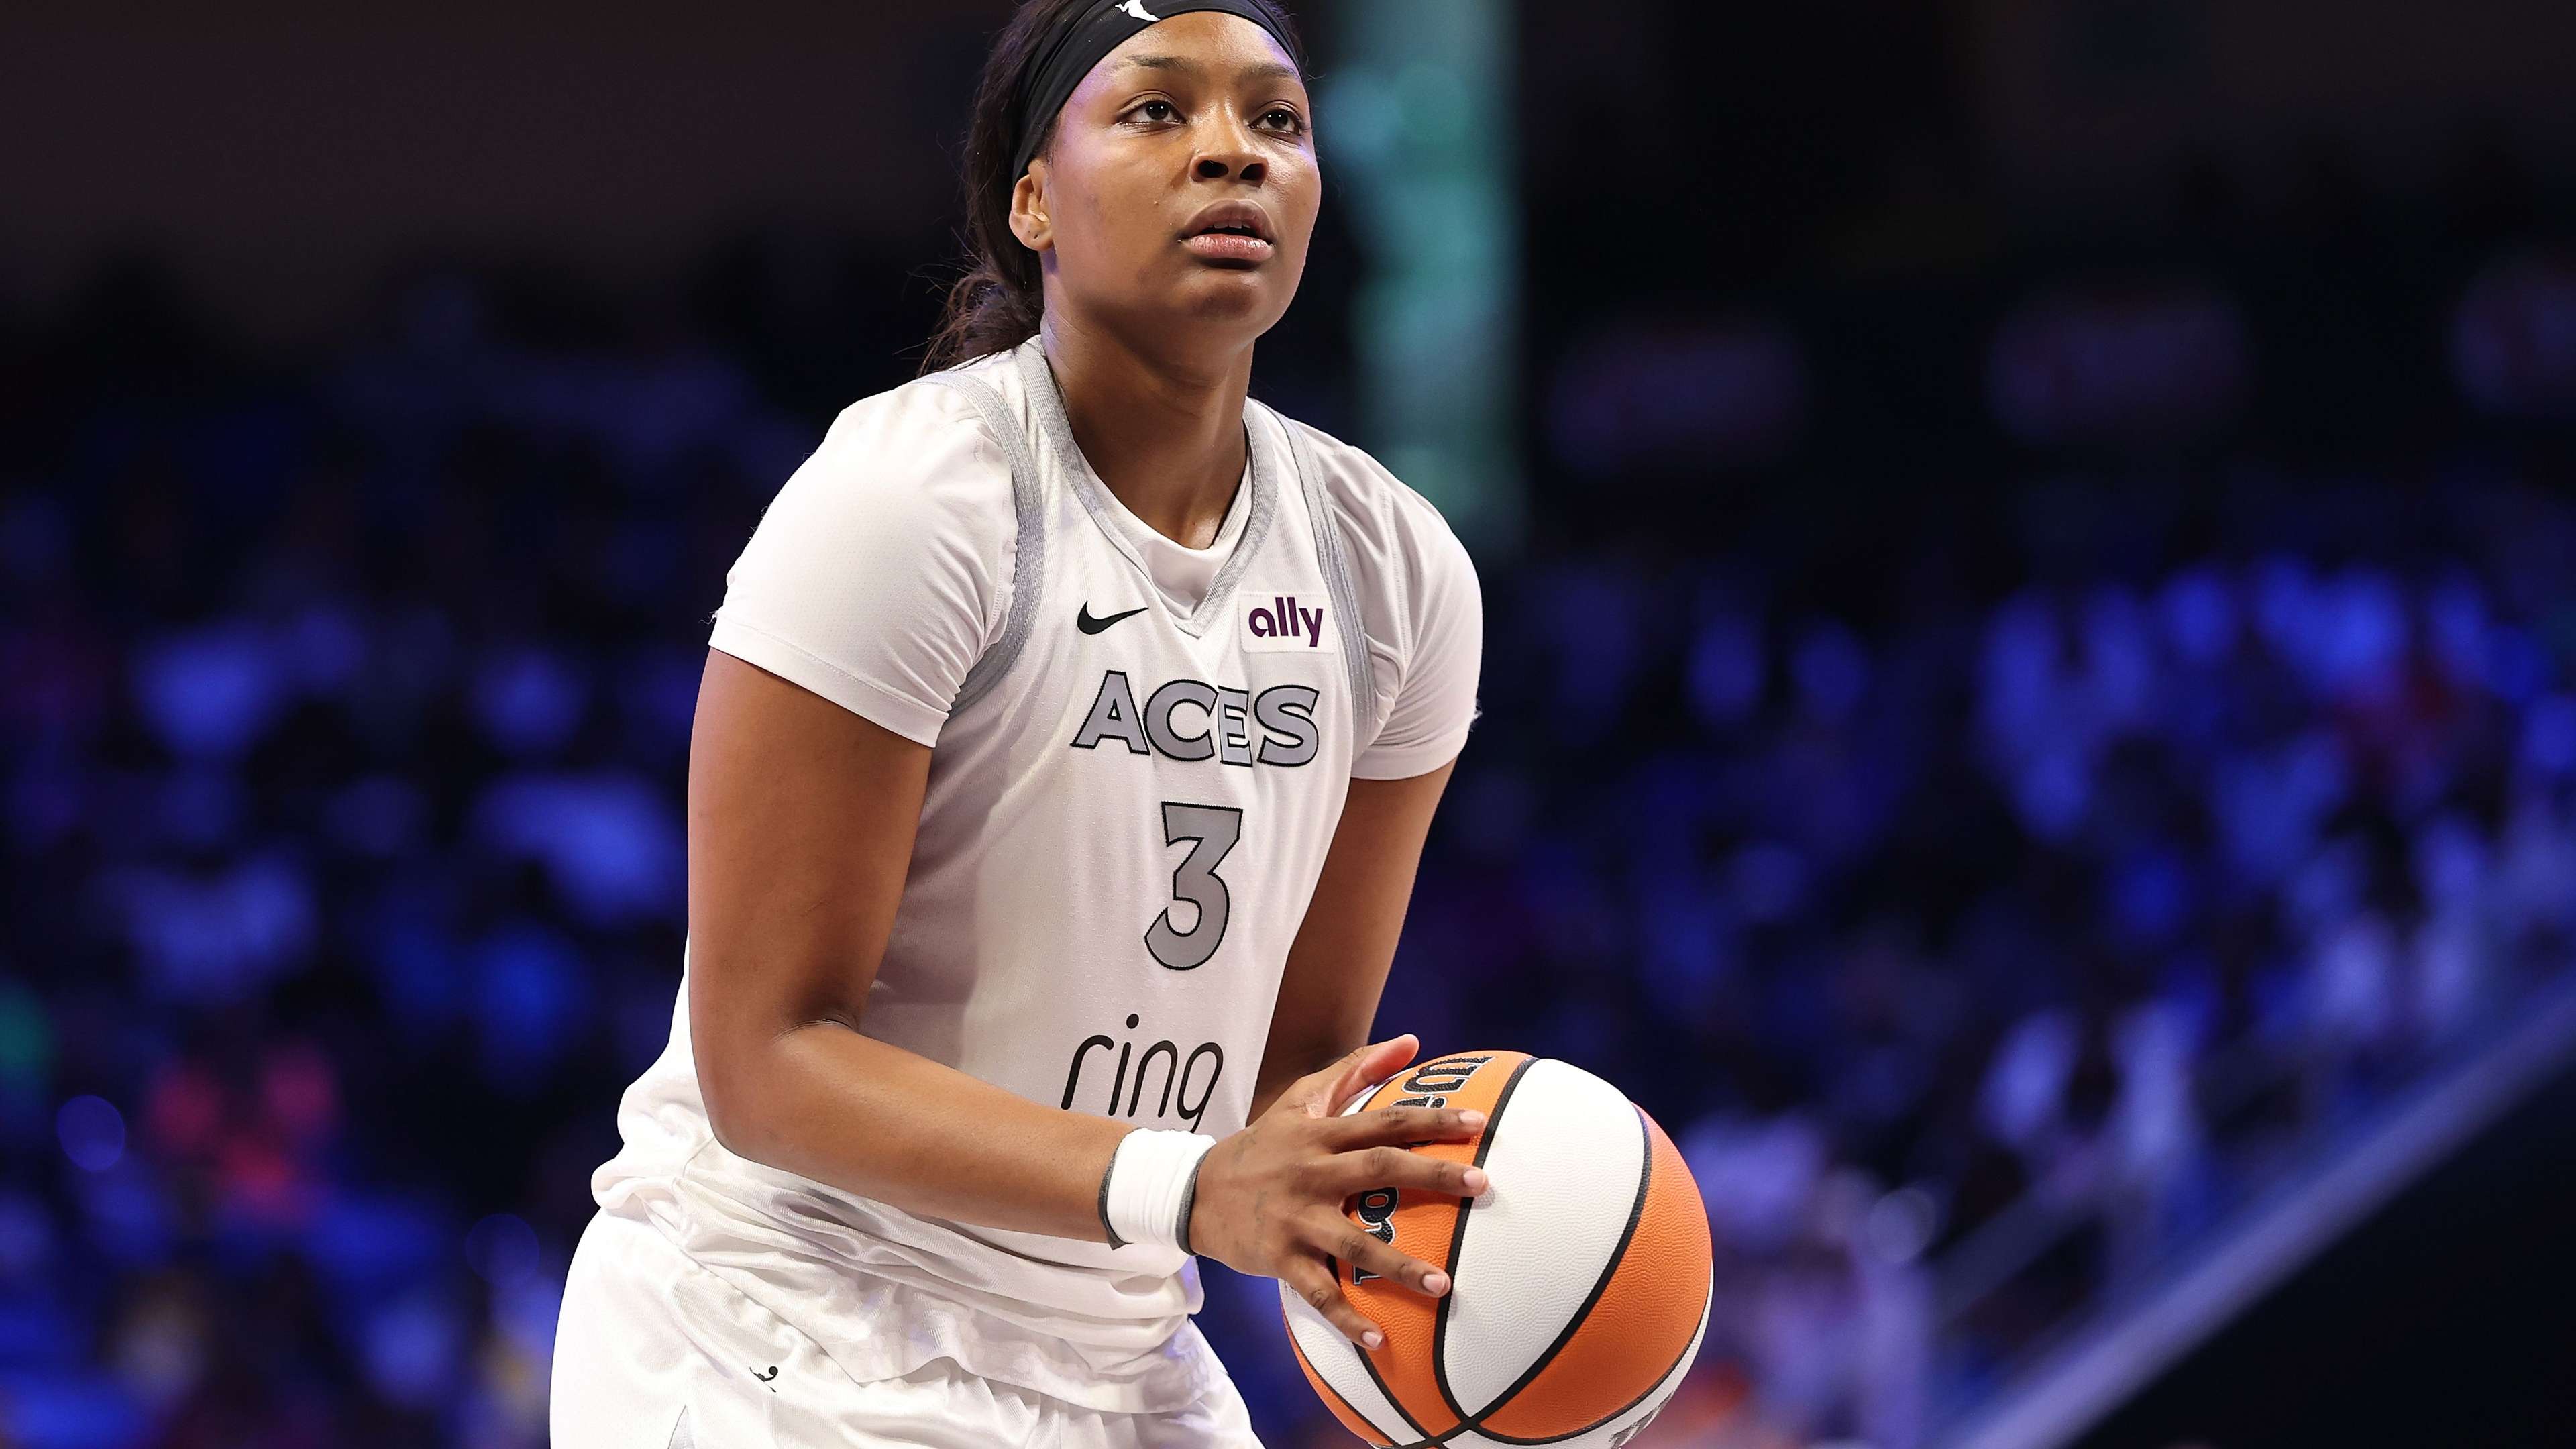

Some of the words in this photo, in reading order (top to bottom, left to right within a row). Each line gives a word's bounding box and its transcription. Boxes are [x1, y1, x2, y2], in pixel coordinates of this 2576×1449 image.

[1248, 596, 1324, 647] ally
[1071, 670, 1320, 767] ACES
[1144, 802, 1243, 971] 3
[1061, 1014, 1224, 1134] ring
